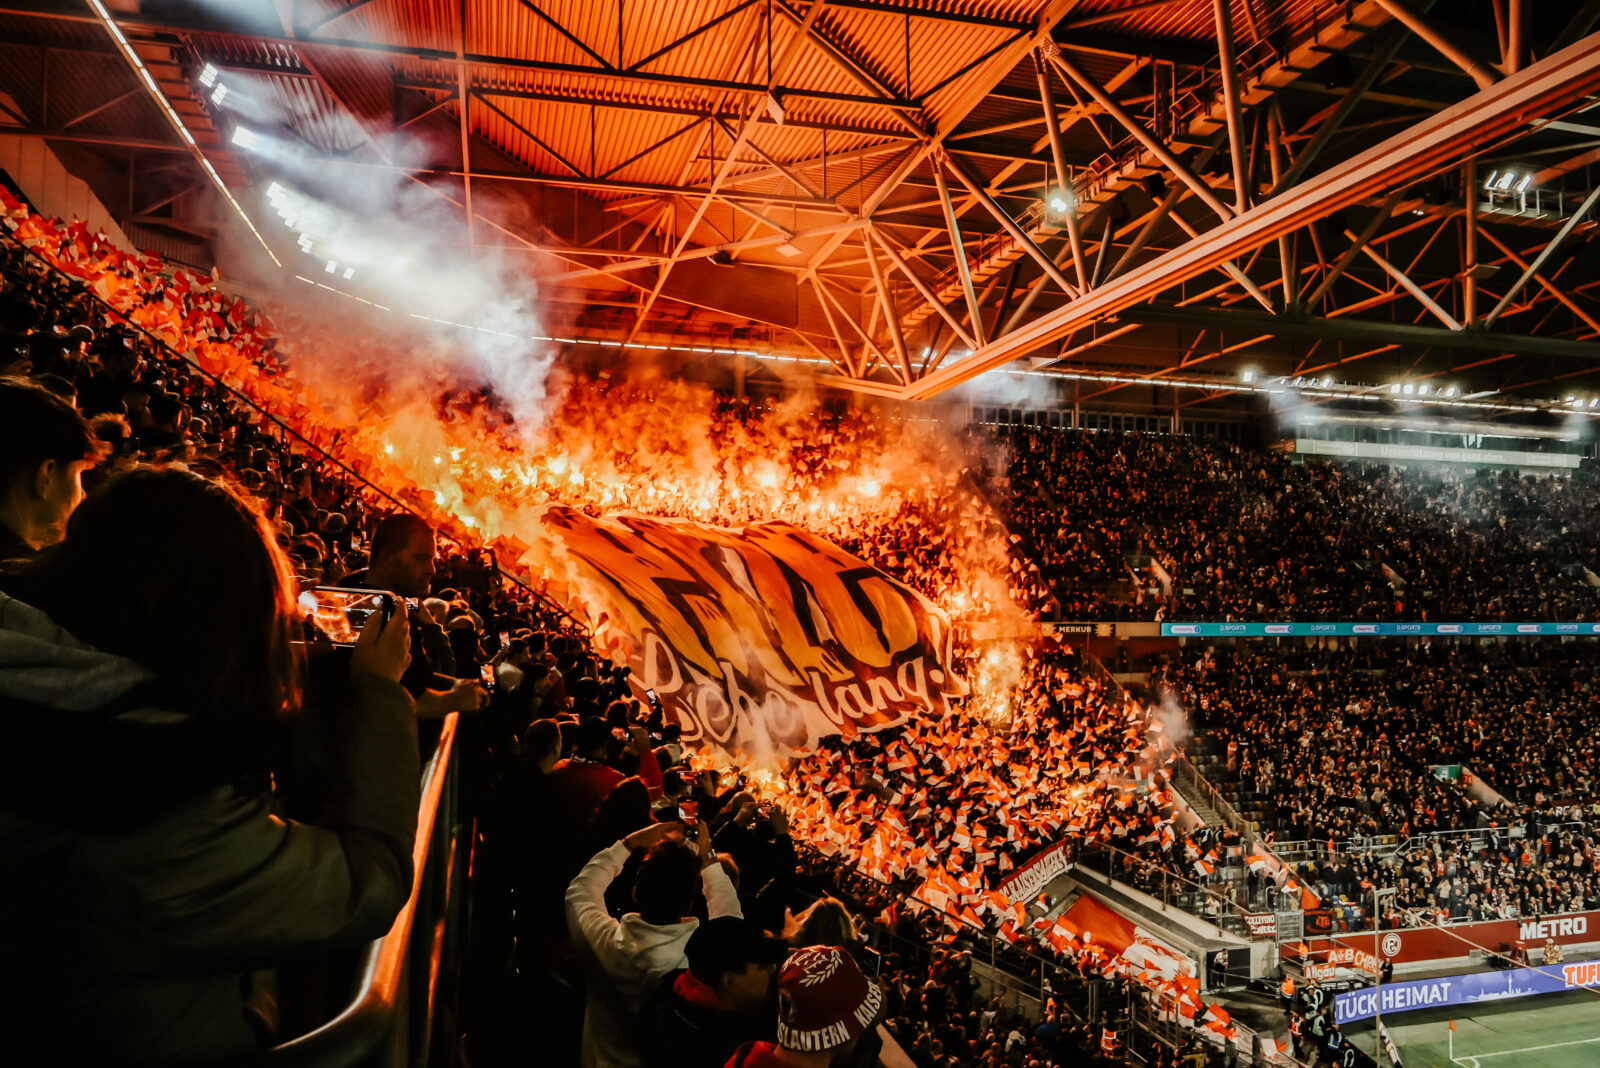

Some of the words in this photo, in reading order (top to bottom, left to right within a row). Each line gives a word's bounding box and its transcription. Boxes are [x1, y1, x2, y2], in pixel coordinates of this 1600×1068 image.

[1519, 916, 1588, 941] METRO
[1305, 964, 1336, 981] Allgäu
[1335, 991, 1379, 1020] TÜCK
[1381, 982, 1452, 1010] HEIMAT
[777, 1017, 851, 1053] SLAUTERN
